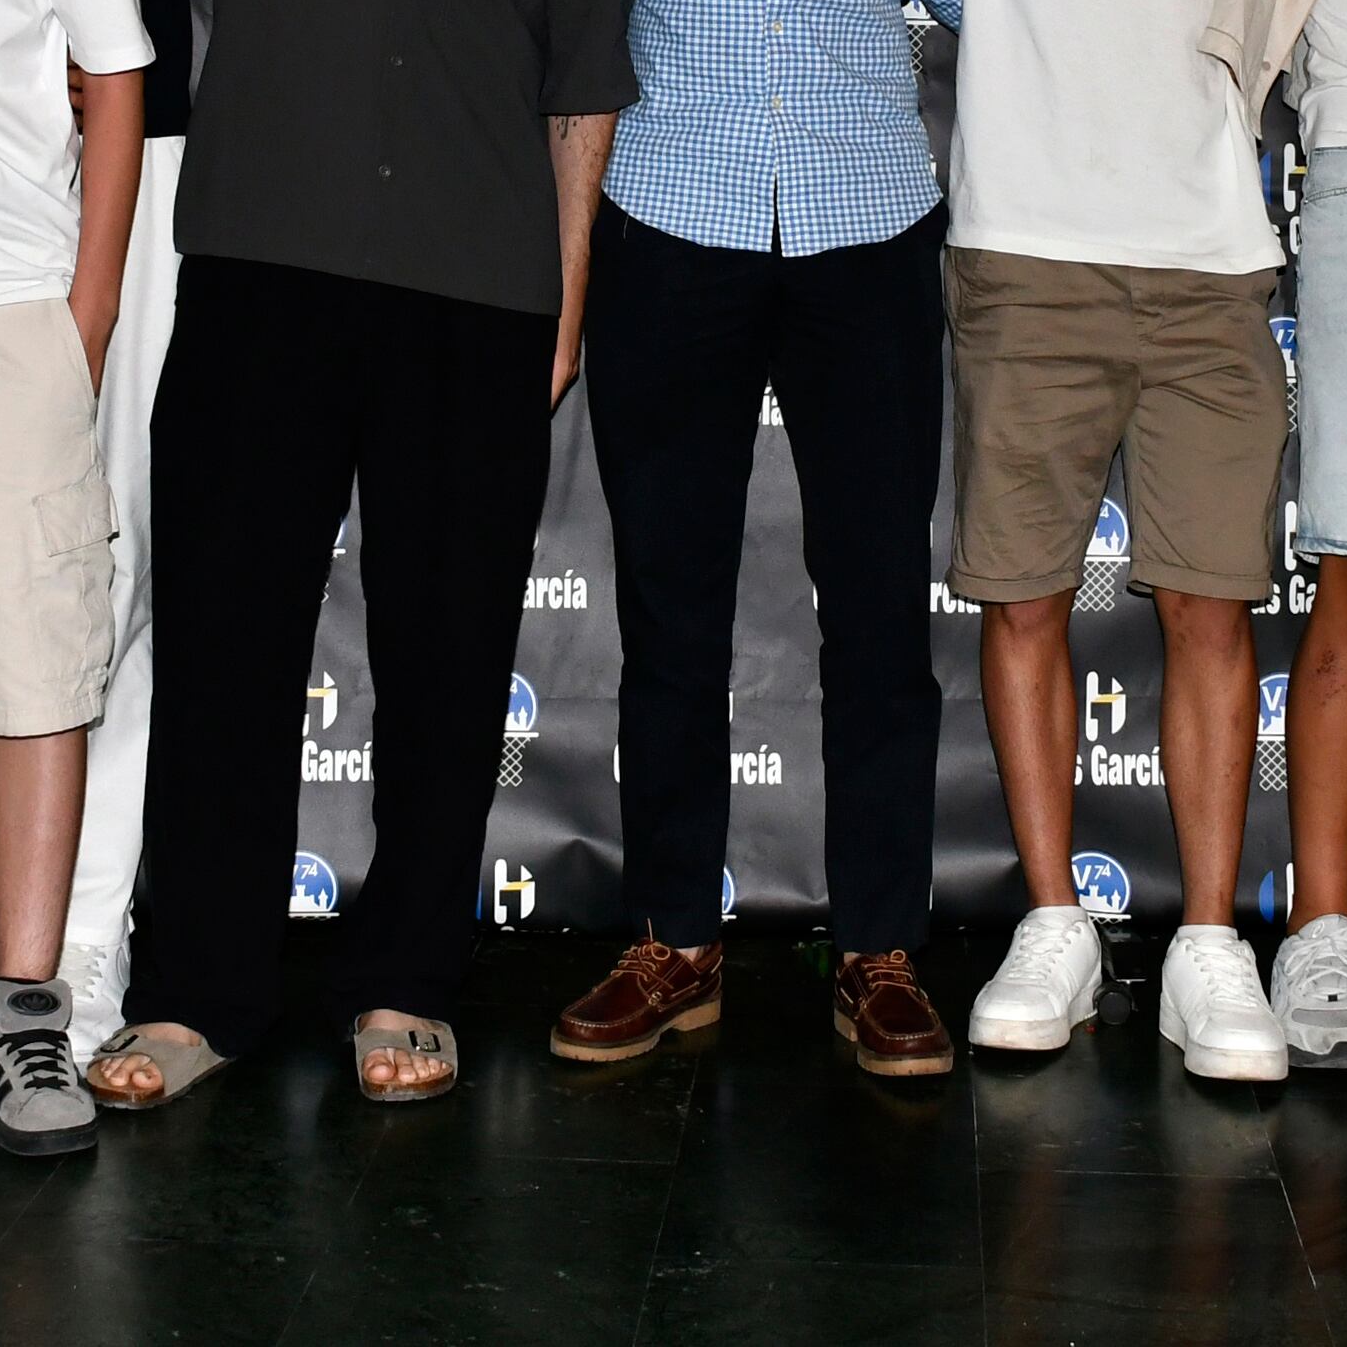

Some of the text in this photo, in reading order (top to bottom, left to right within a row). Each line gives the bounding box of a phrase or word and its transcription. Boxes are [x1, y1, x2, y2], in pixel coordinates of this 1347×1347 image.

[523, 569, 588, 609] arcía
[301, 740, 374, 783] Garcí
[1090, 745, 1166, 786] Garcí
